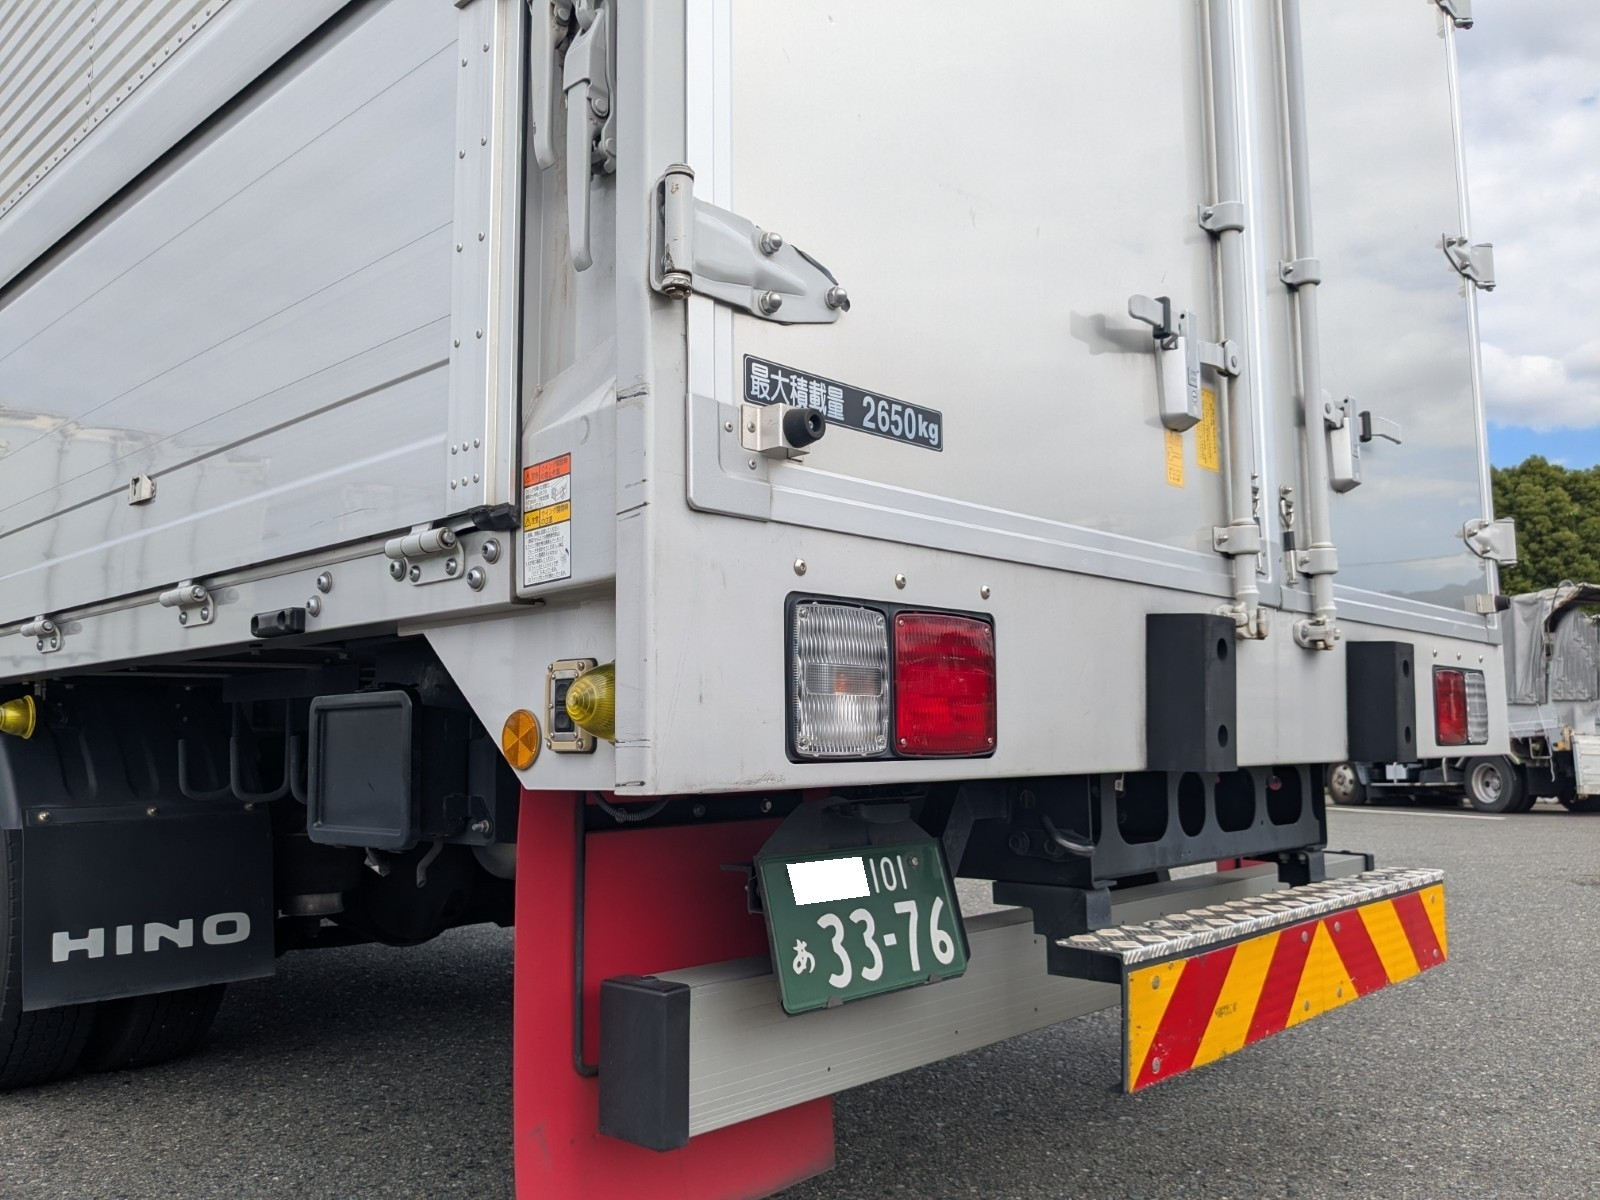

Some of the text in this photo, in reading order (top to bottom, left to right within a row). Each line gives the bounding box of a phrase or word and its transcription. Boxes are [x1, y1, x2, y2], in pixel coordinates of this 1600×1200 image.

[750, 363, 939, 446] 最大積載量 2650kg
[869, 855, 908, 894] 101
[52, 912, 250, 962] HINO
[792, 896, 955, 989] あ 33-76
